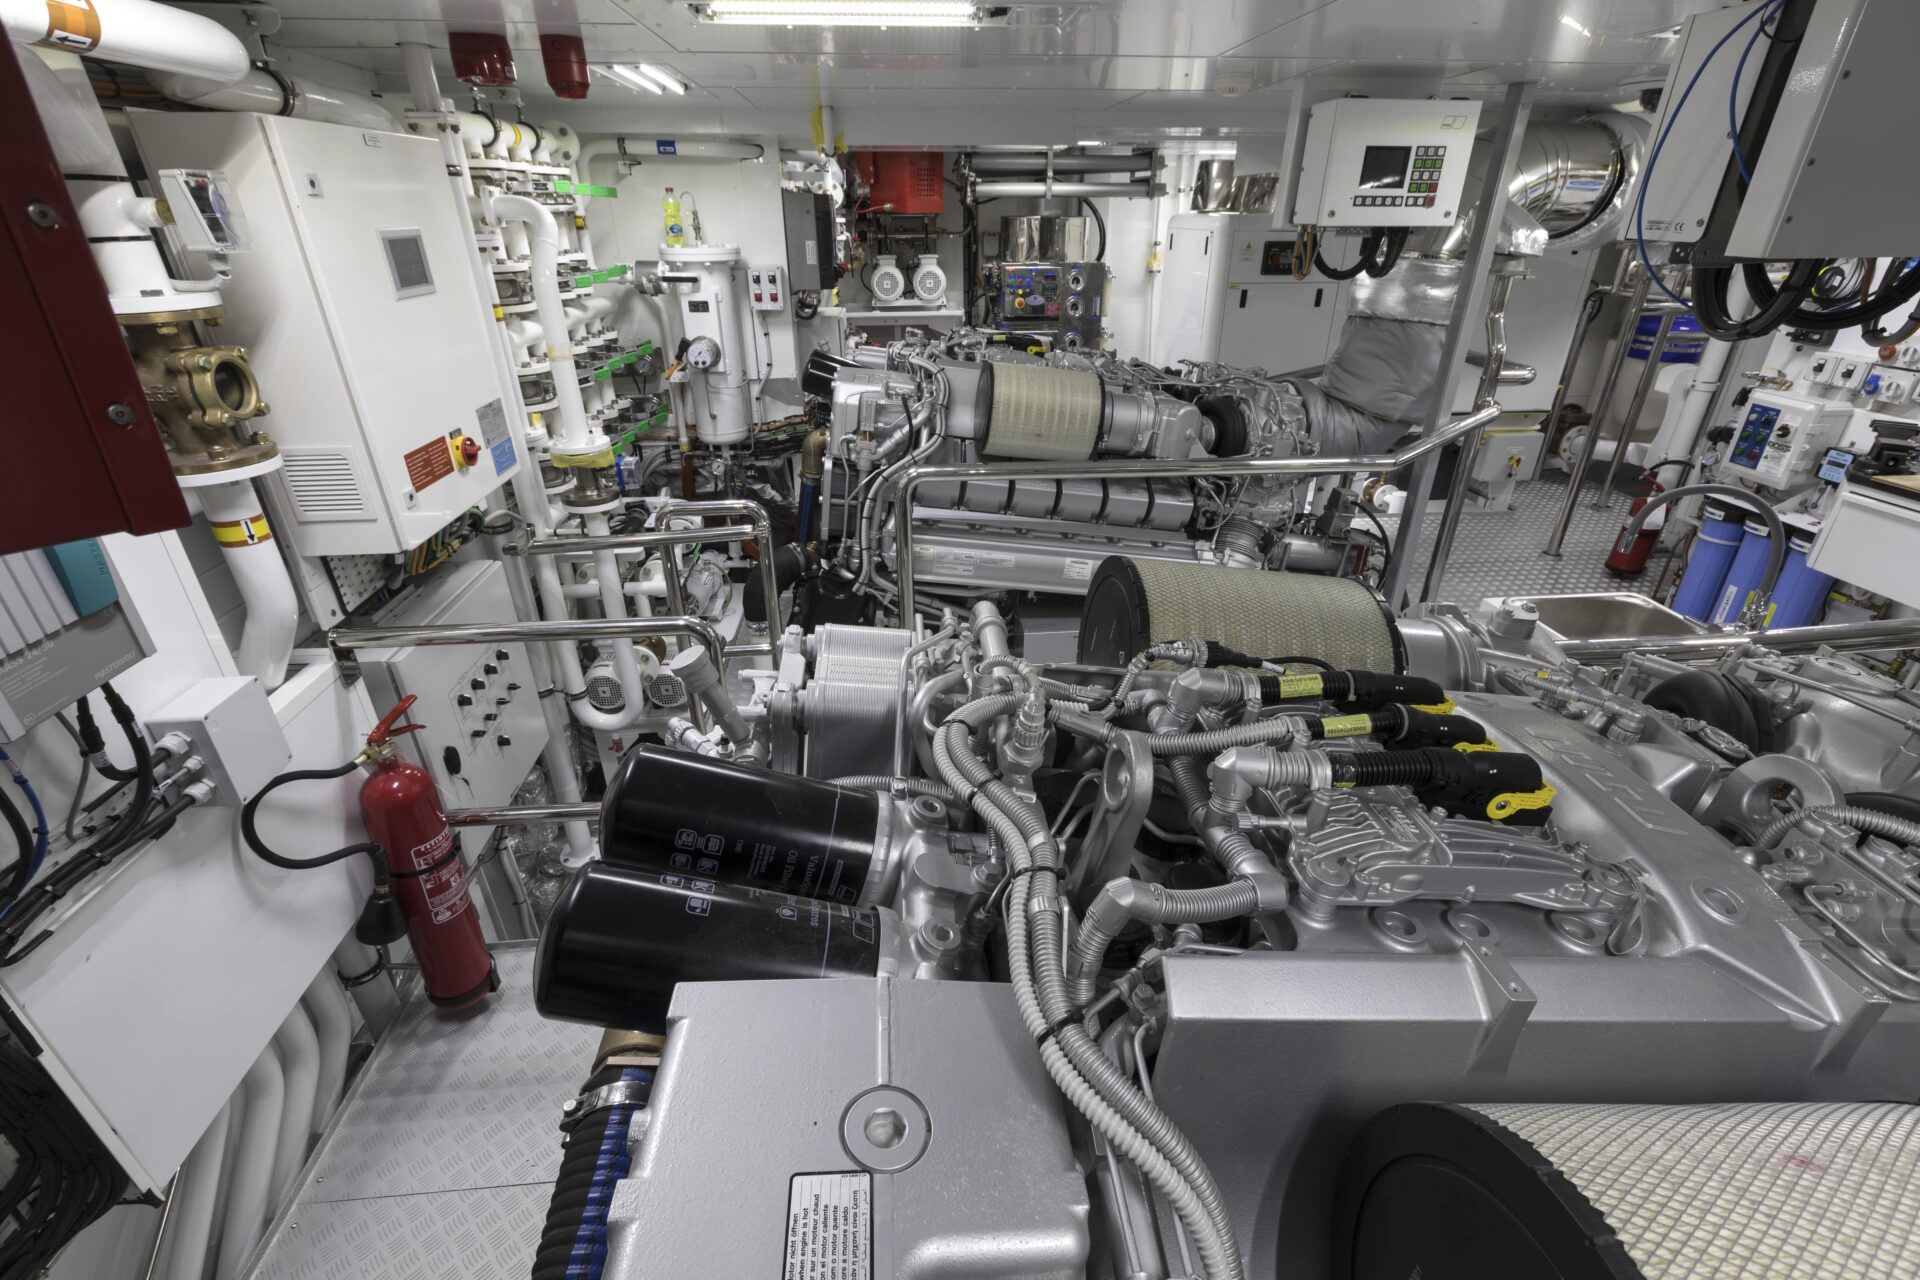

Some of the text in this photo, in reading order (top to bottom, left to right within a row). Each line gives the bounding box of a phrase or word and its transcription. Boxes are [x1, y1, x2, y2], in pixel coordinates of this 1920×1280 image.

[94, 649, 137, 680] MASTERVOLT
[802, 1221, 808, 1229] is
[812, 1247, 817, 1258] un
[821, 1261, 827, 1269] el
